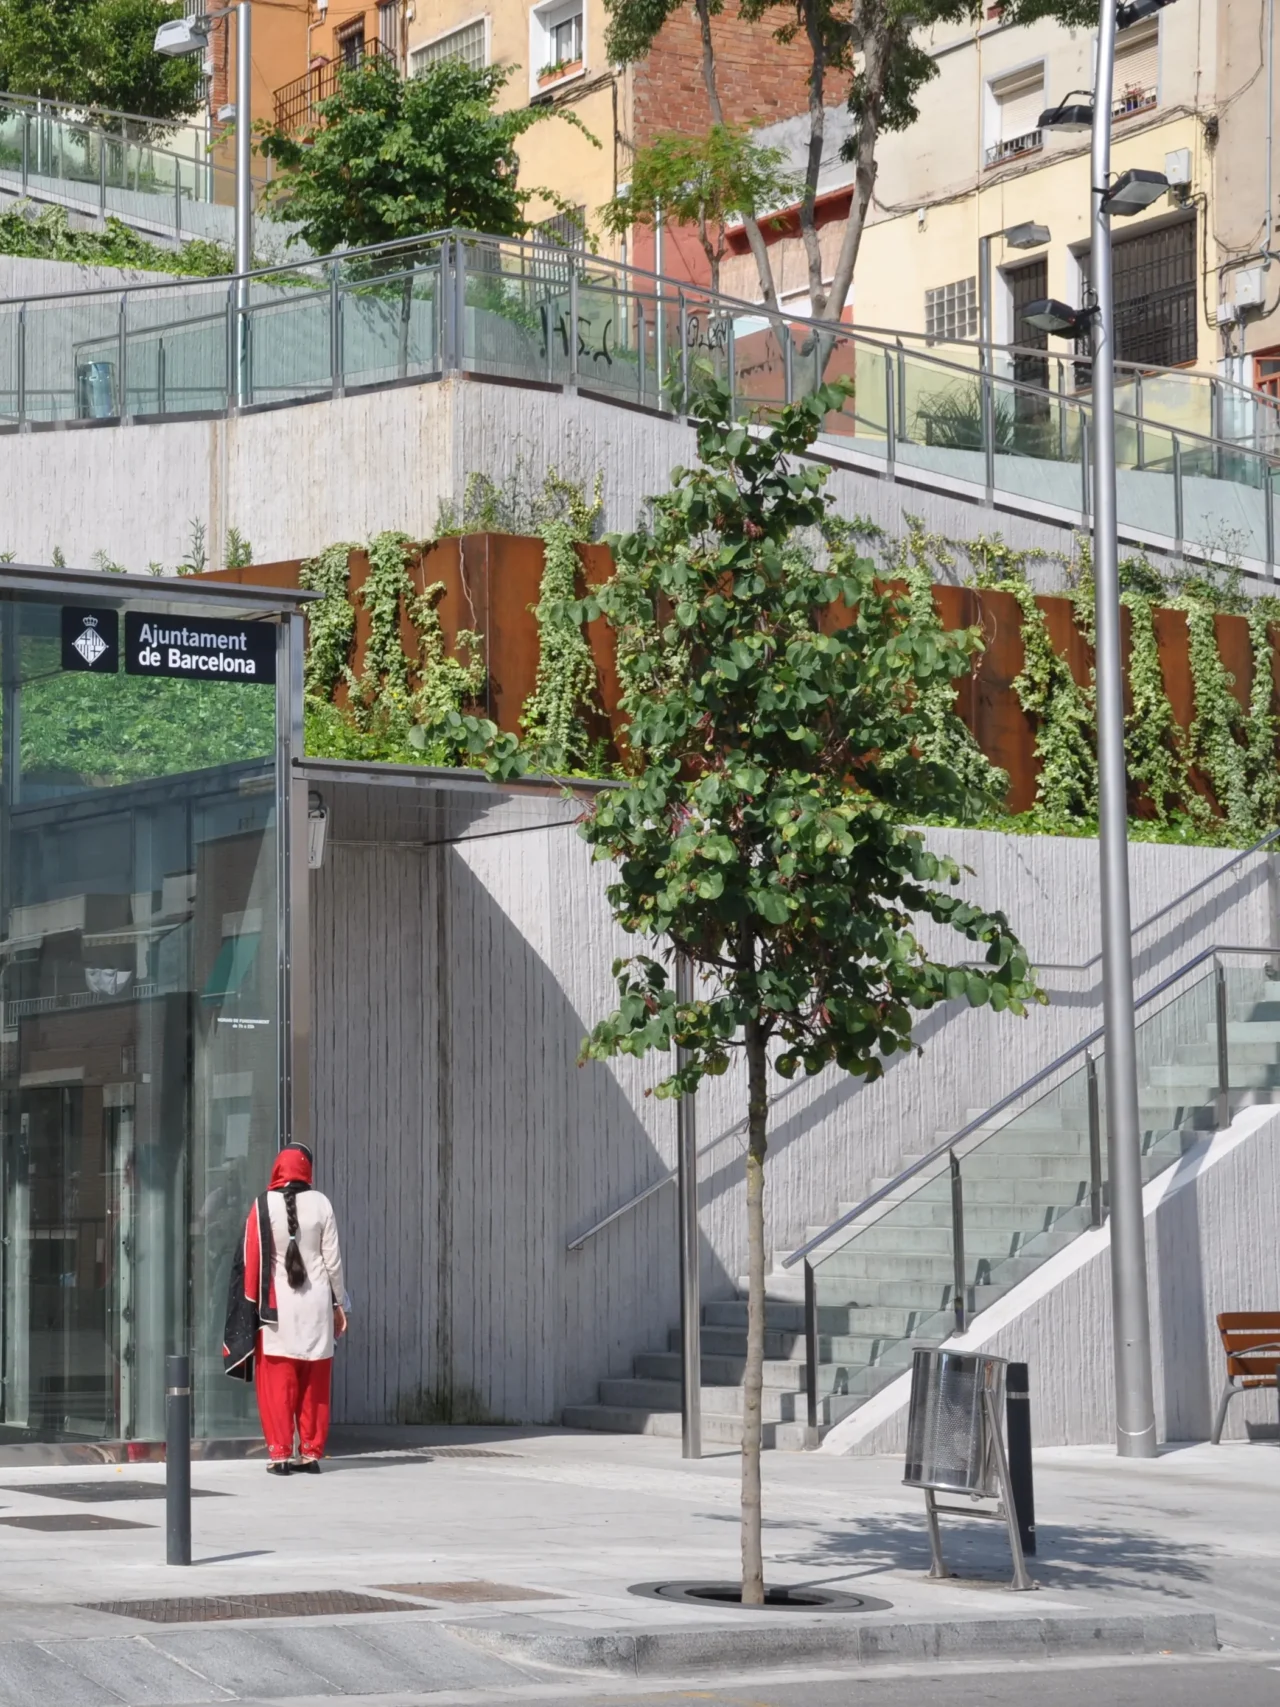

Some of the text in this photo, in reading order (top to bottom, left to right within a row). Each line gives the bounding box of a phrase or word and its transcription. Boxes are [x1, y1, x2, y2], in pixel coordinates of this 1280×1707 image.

[139, 623, 247, 651] Ajuntament
[138, 646, 256, 674] de Barcelona
